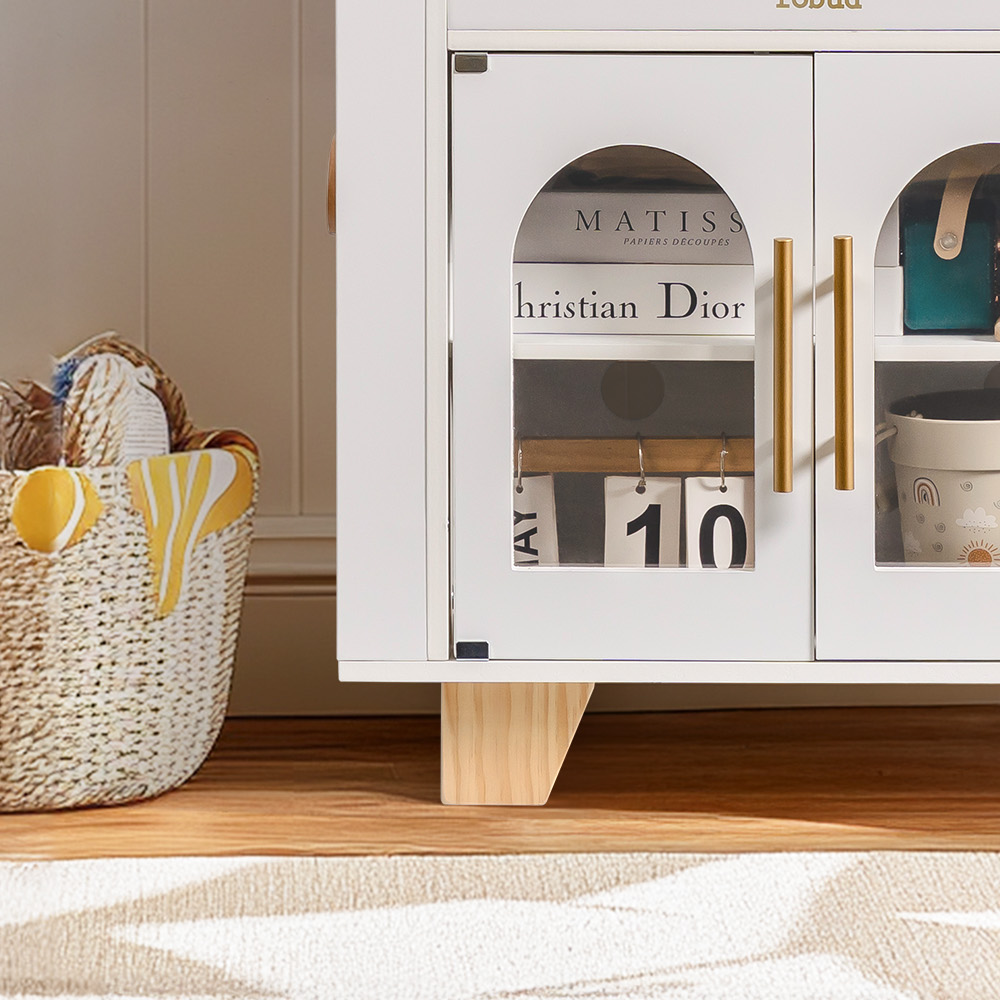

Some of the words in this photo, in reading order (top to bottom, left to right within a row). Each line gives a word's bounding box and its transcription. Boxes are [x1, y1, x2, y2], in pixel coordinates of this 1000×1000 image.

[623, 237, 668, 246] PAPIERS
[657, 281, 745, 319] Dior
[514, 510, 539, 564] AY
